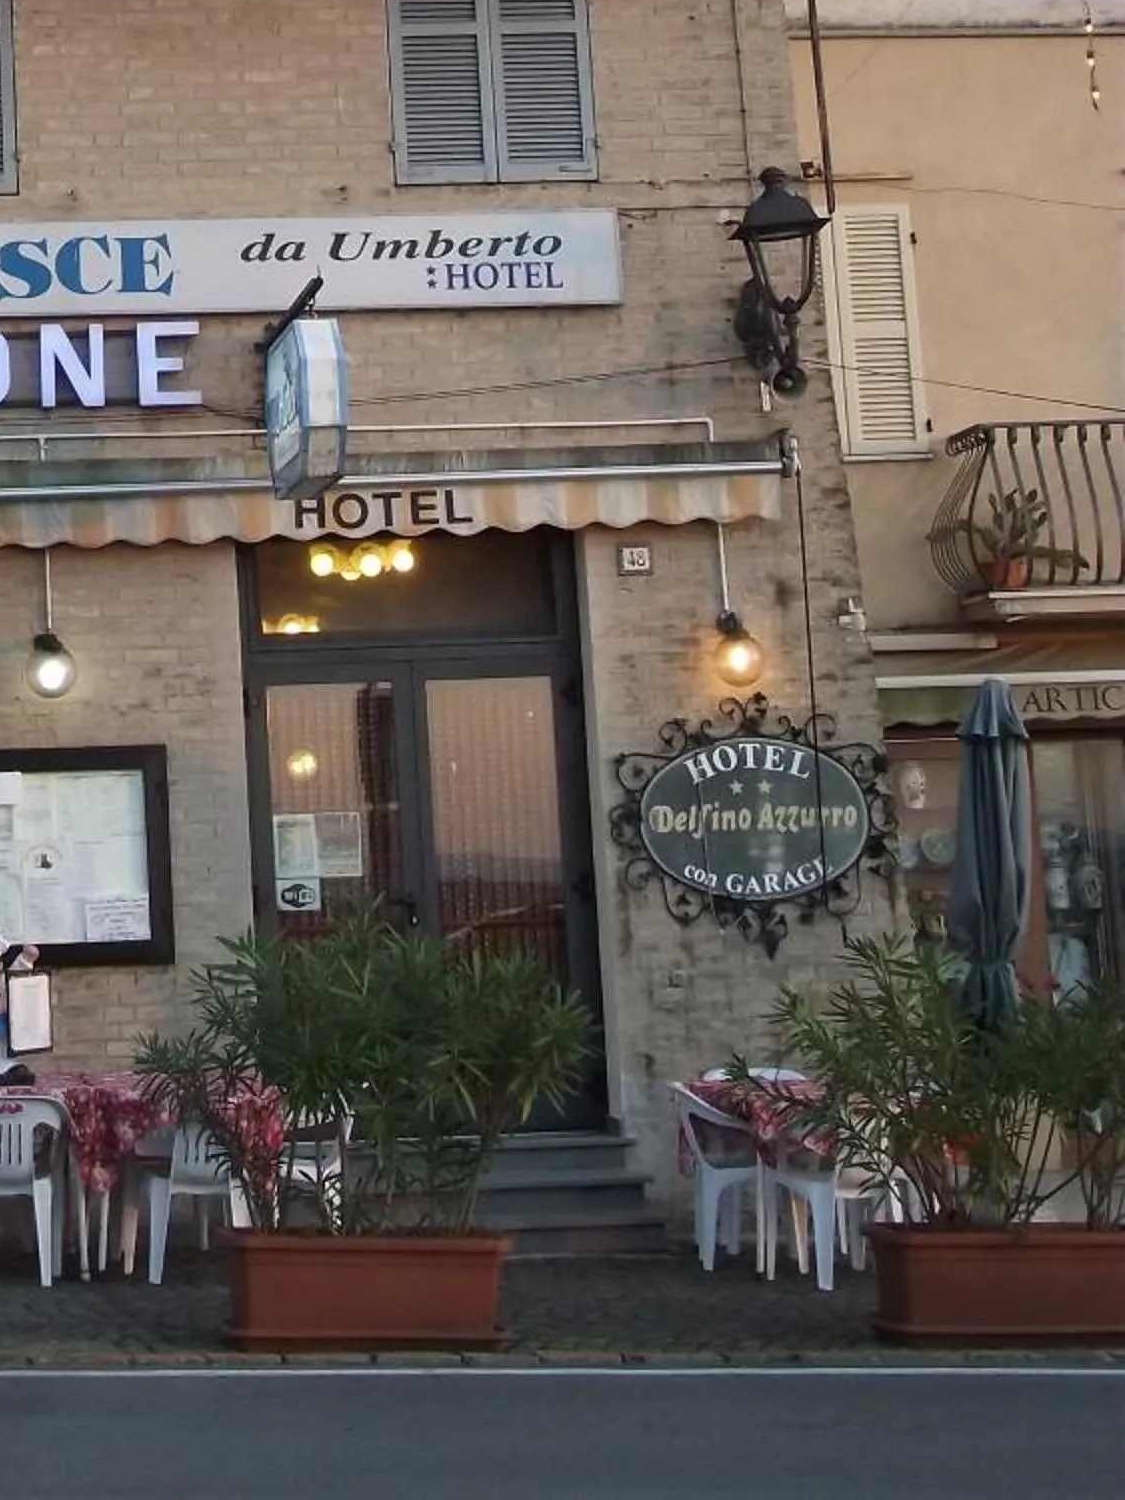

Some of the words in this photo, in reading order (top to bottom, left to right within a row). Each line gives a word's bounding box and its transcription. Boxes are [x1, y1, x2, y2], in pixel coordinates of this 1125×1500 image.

[240, 234, 305, 262] da
[328, 230, 562, 261] Umberto
[446, 262, 563, 290] HOTEL
[294, 490, 473, 529] HOTEL
[683, 743, 811, 784] HOTEL
[650, 803, 751, 839] Delfino
[756, 803, 857, 833] Azzurro
[683, 863, 717, 887] con
